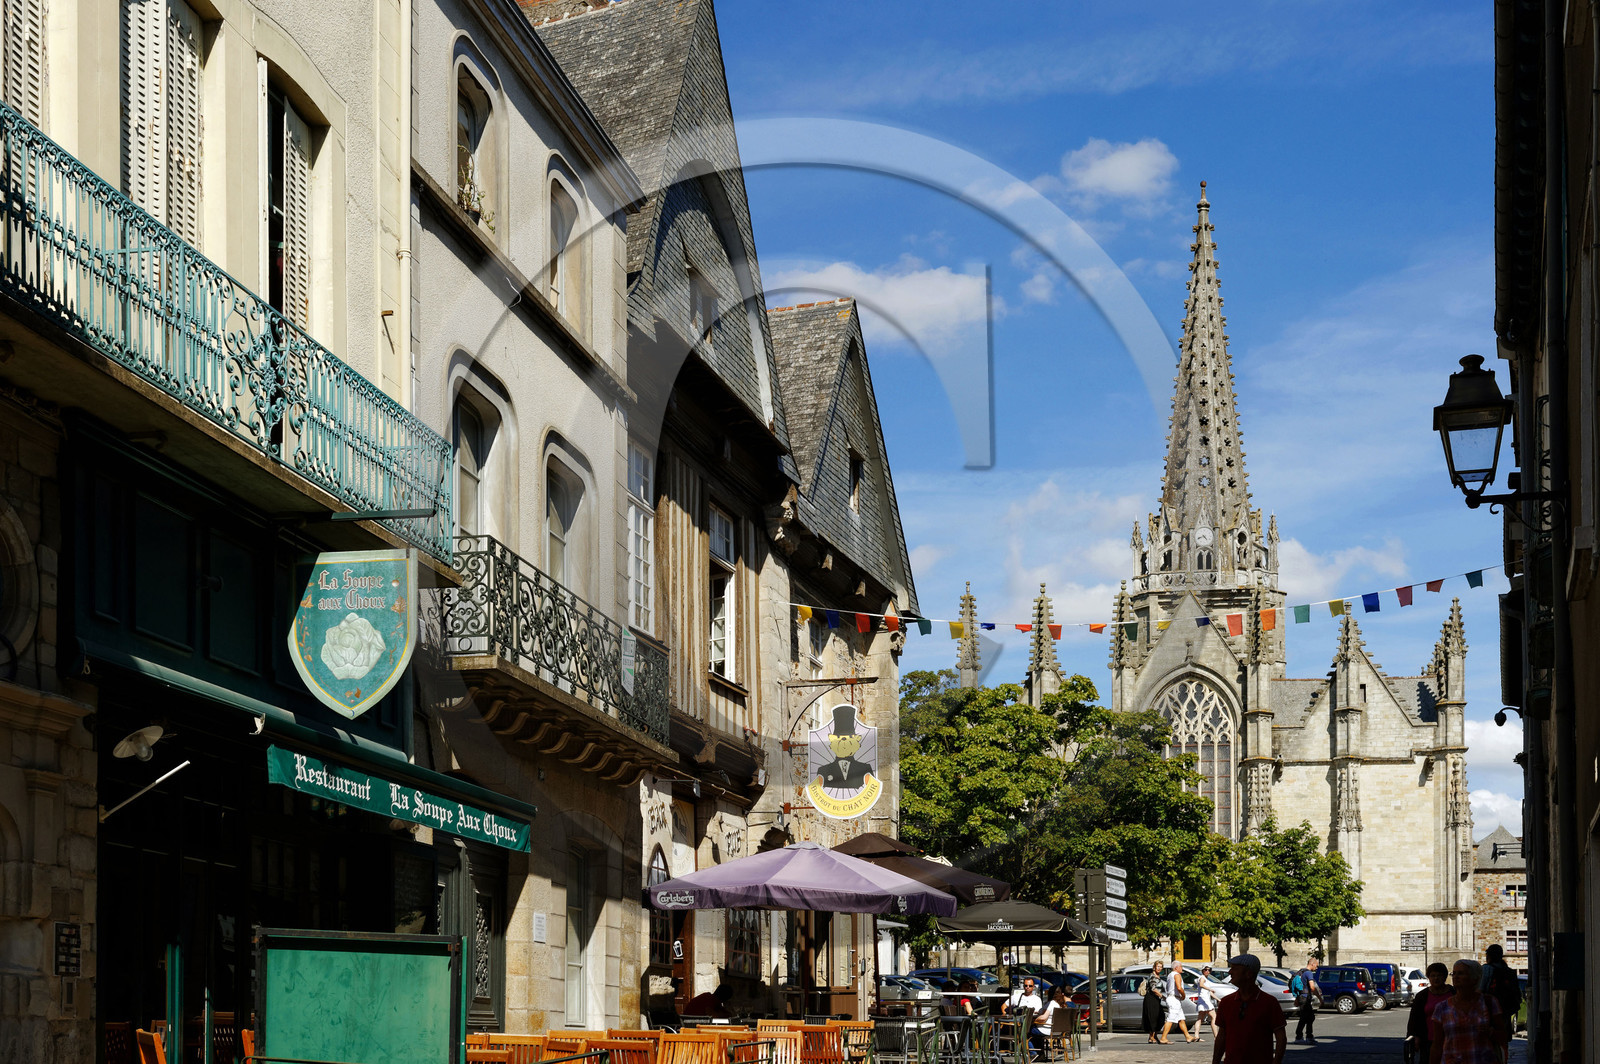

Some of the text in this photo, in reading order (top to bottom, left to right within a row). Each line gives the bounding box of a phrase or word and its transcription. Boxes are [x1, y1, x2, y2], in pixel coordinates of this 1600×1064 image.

[318, 568, 384, 593] La Soupe
[318, 589, 386, 610] aux Choux
[294, 753, 371, 800] Restaurant
[842, 799, 863, 811] CHAT
[863, 783, 878, 802] NOIR
[389, 783, 517, 843] La Soupe Aux Choux
[648, 801, 668, 835] BAR
[656, 890, 694, 906] Carlsberg
